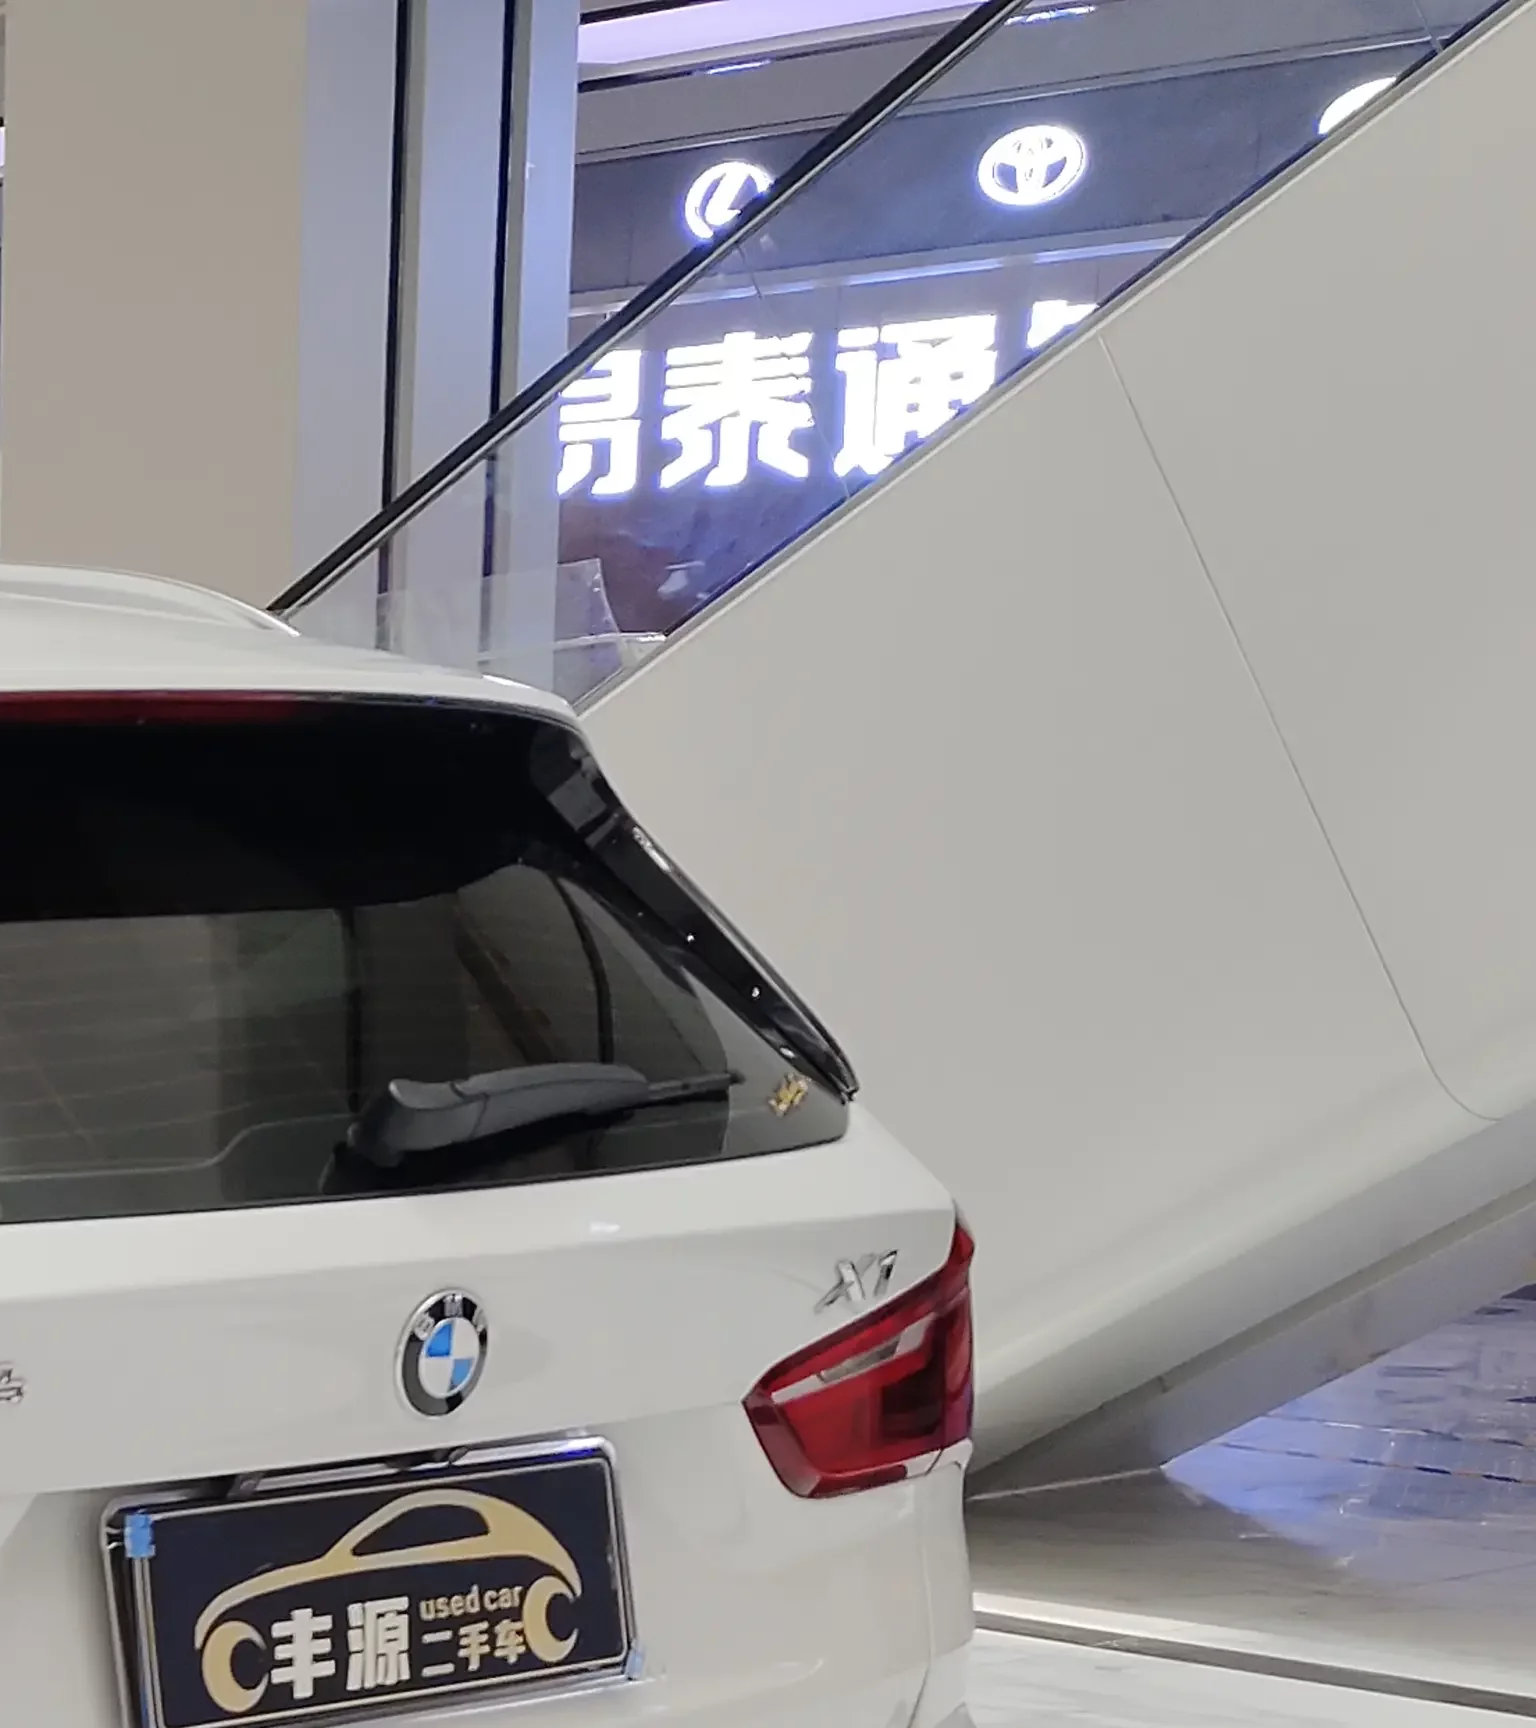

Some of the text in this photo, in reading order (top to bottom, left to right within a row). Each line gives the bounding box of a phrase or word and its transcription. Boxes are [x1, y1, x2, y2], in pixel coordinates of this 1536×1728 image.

[814, 1249, 898, 1315] X1
[419, 1584, 523, 1622] used car
[270, 1596, 411, 1700] 丰源
[421, 1618, 526, 1679] 二手车
